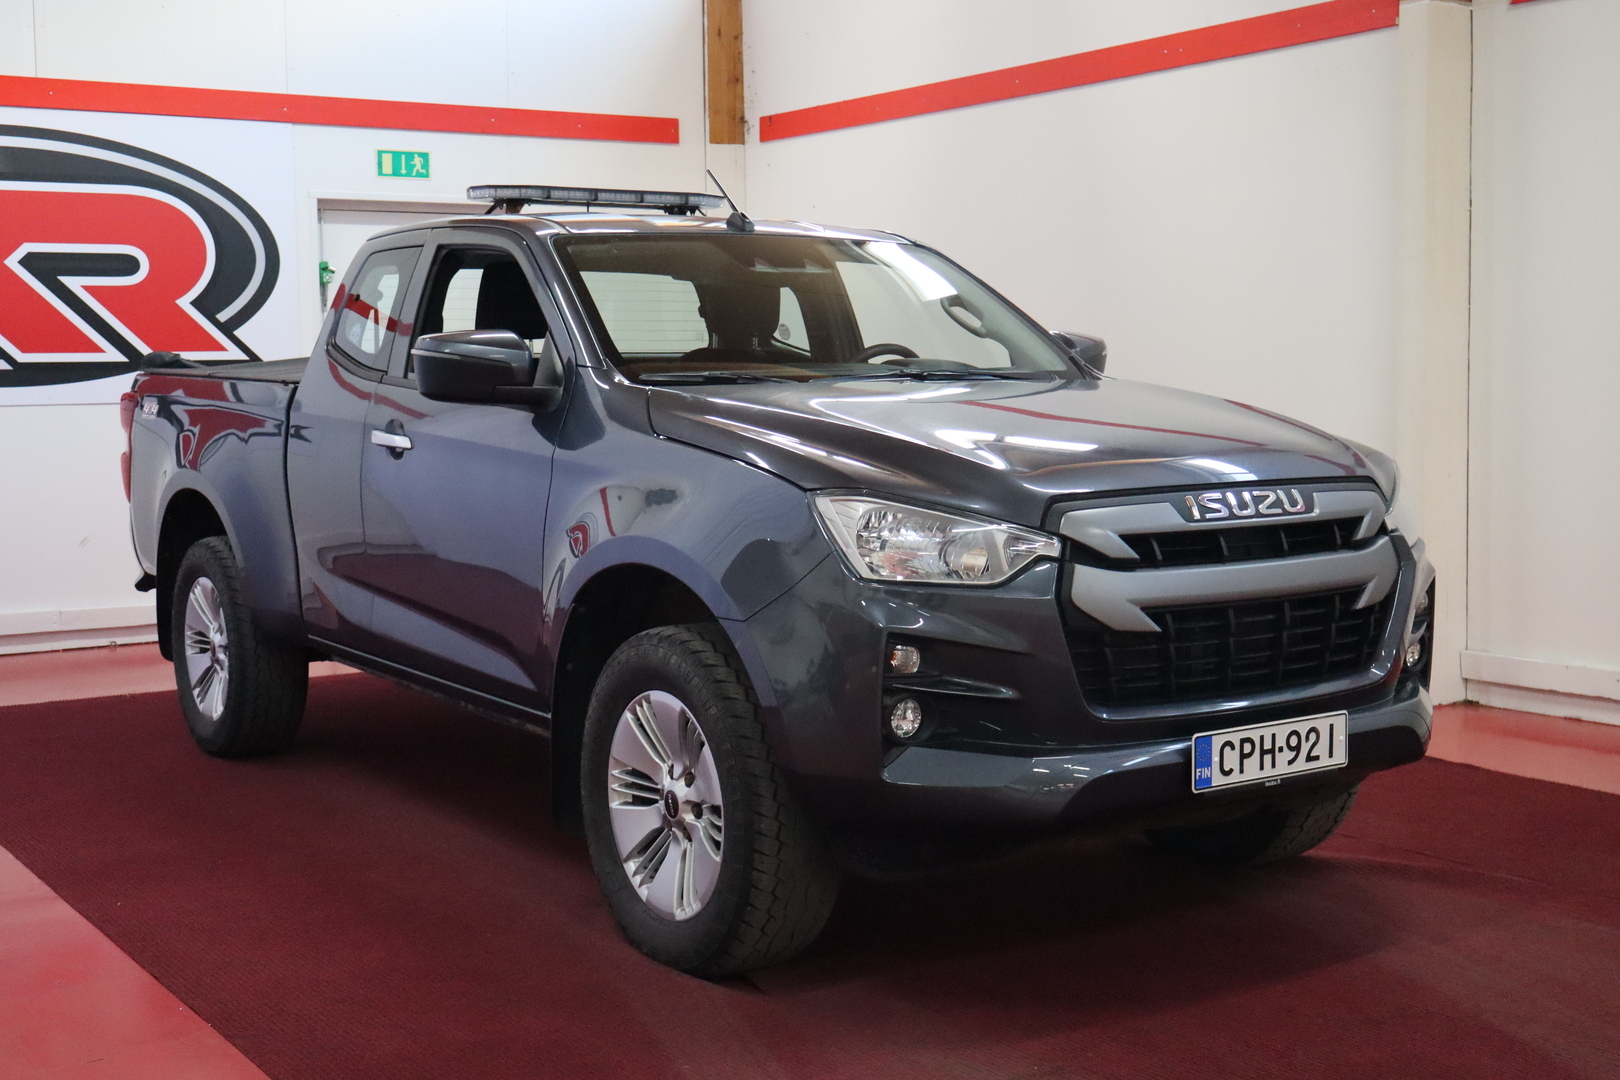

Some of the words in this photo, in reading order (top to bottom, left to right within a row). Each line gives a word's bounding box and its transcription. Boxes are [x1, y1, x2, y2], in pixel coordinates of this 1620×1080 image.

[1185, 488, 1306, 520] ISUZU
[1196, 766, 1211, 780] FIN
[1219, 723, 1334, 777] CPH-921
